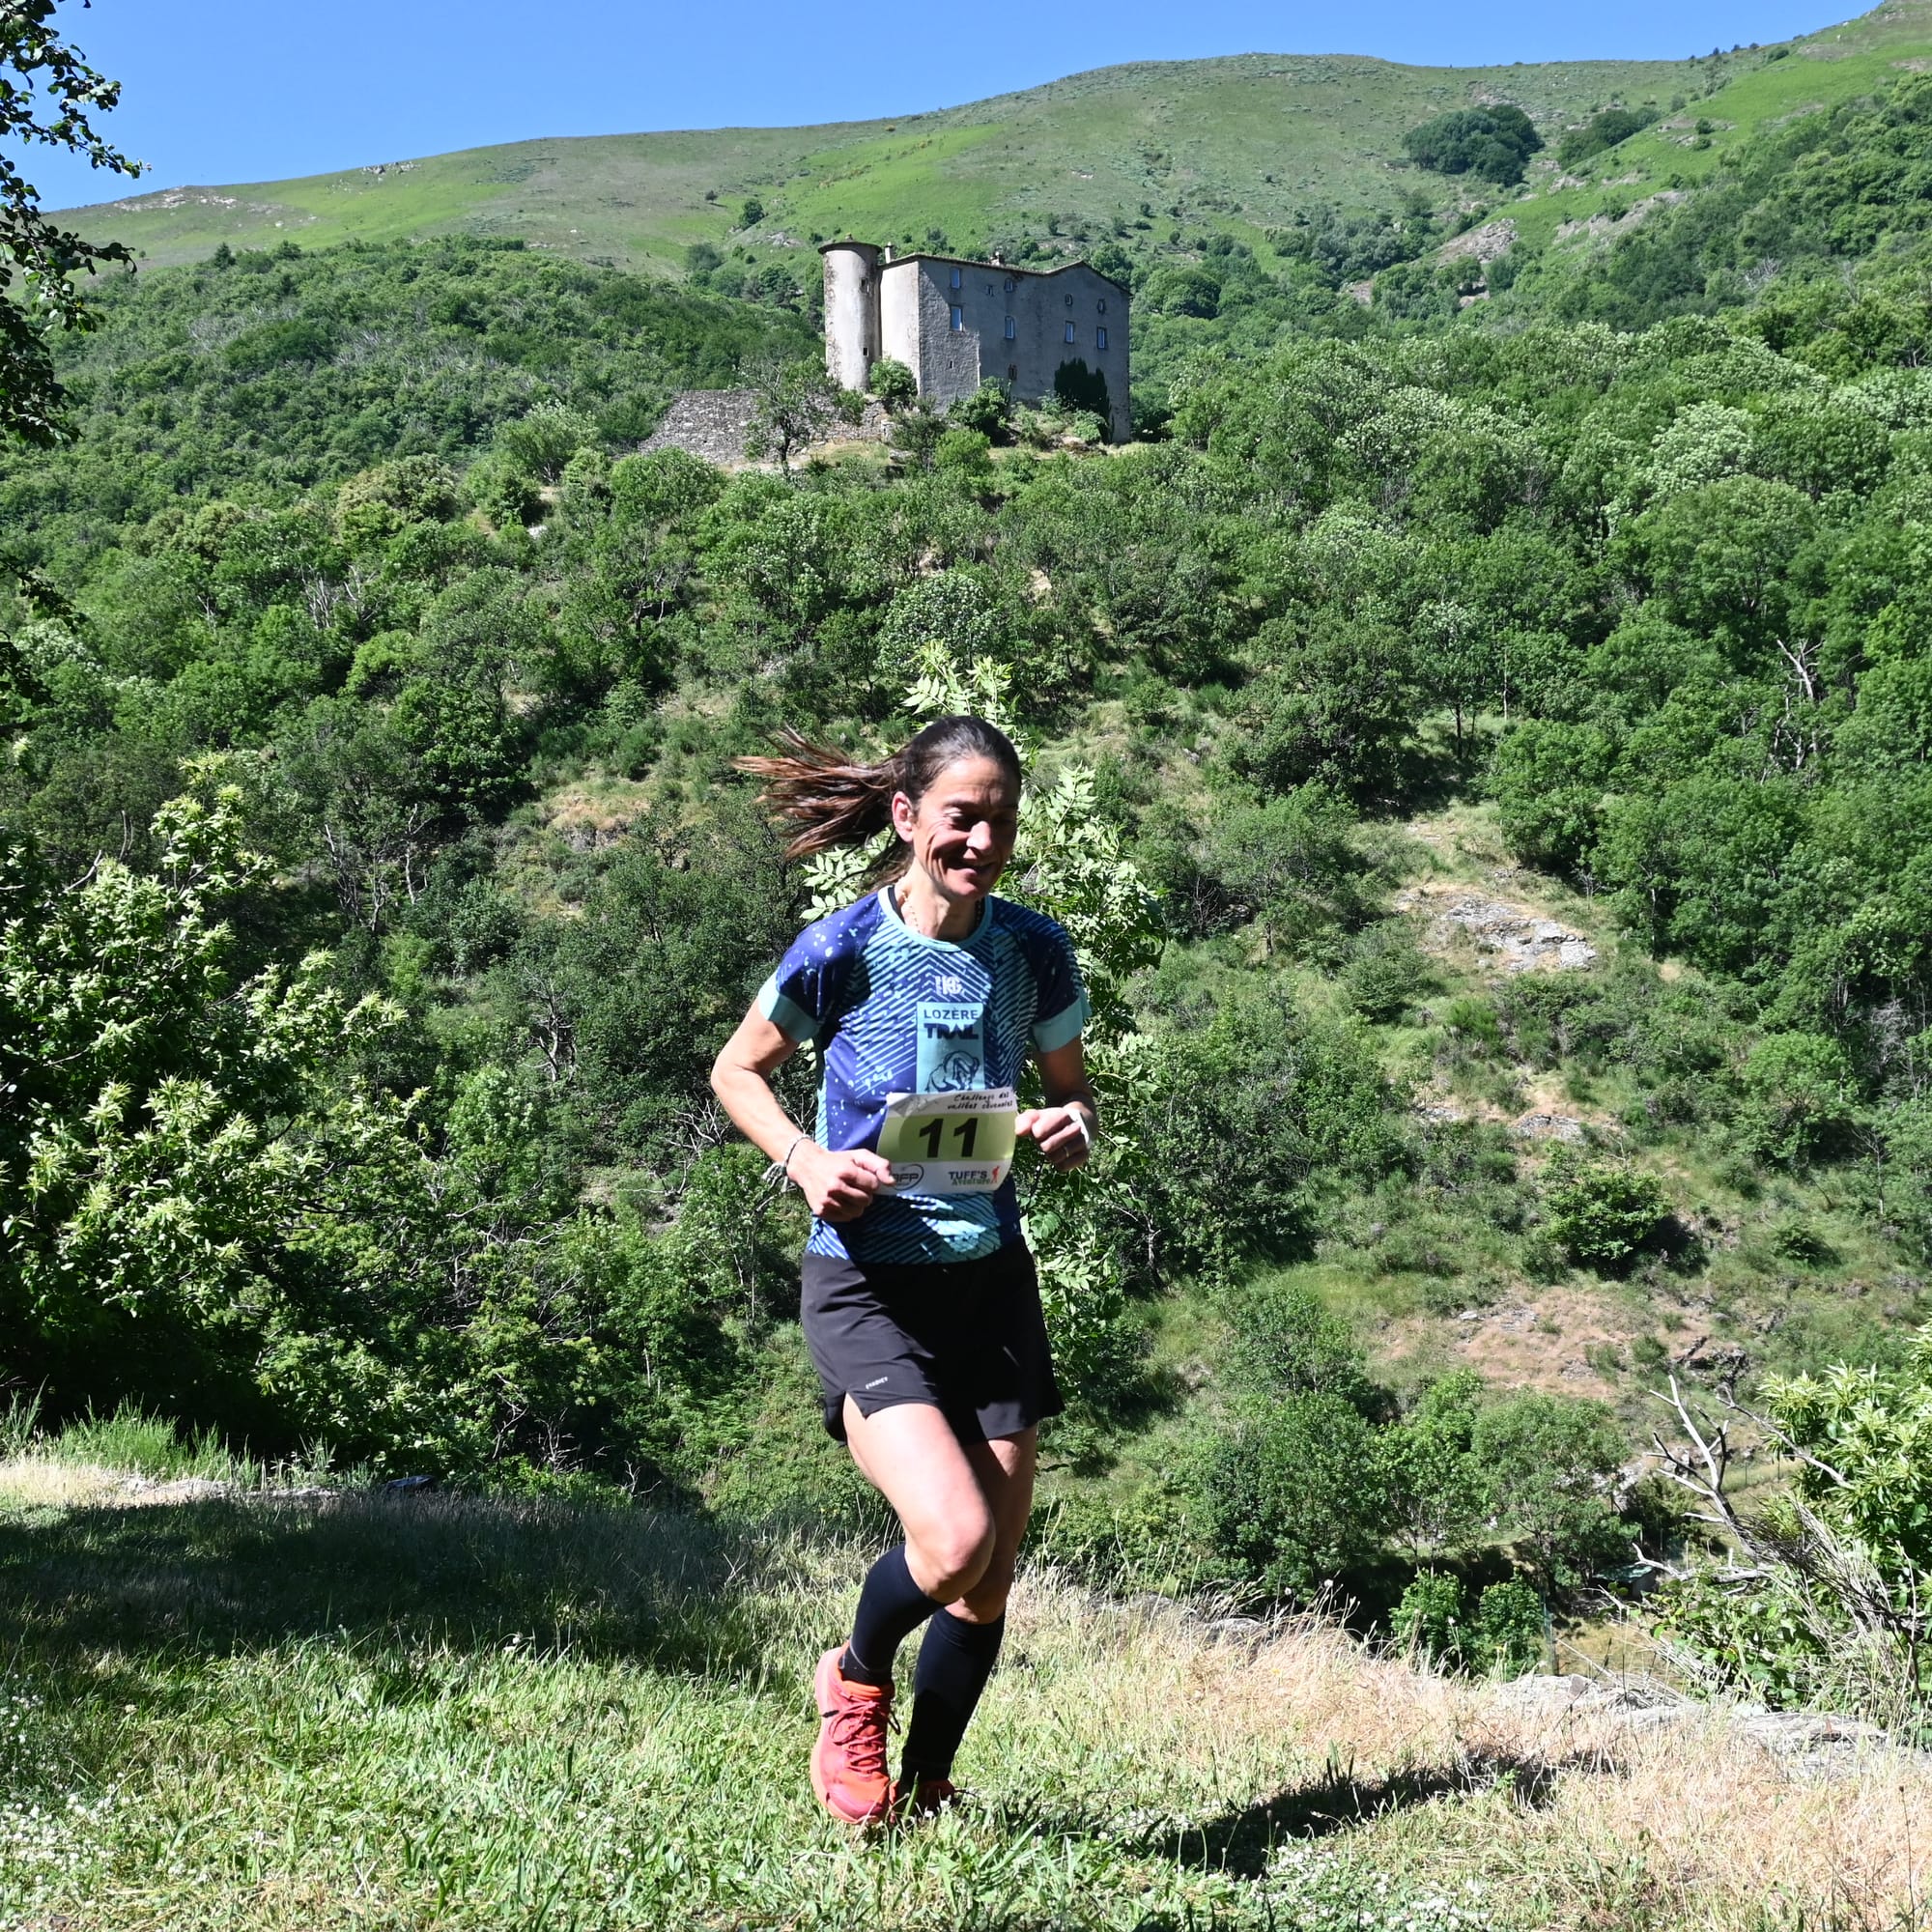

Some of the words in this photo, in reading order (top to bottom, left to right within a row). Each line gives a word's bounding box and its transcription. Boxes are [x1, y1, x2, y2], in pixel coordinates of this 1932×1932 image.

[923, 1007, 979, 1020] LOZÈRE
[919, 1118, 979, 1158] 11
[948, 1170, 987, 1179] TUFF'S
